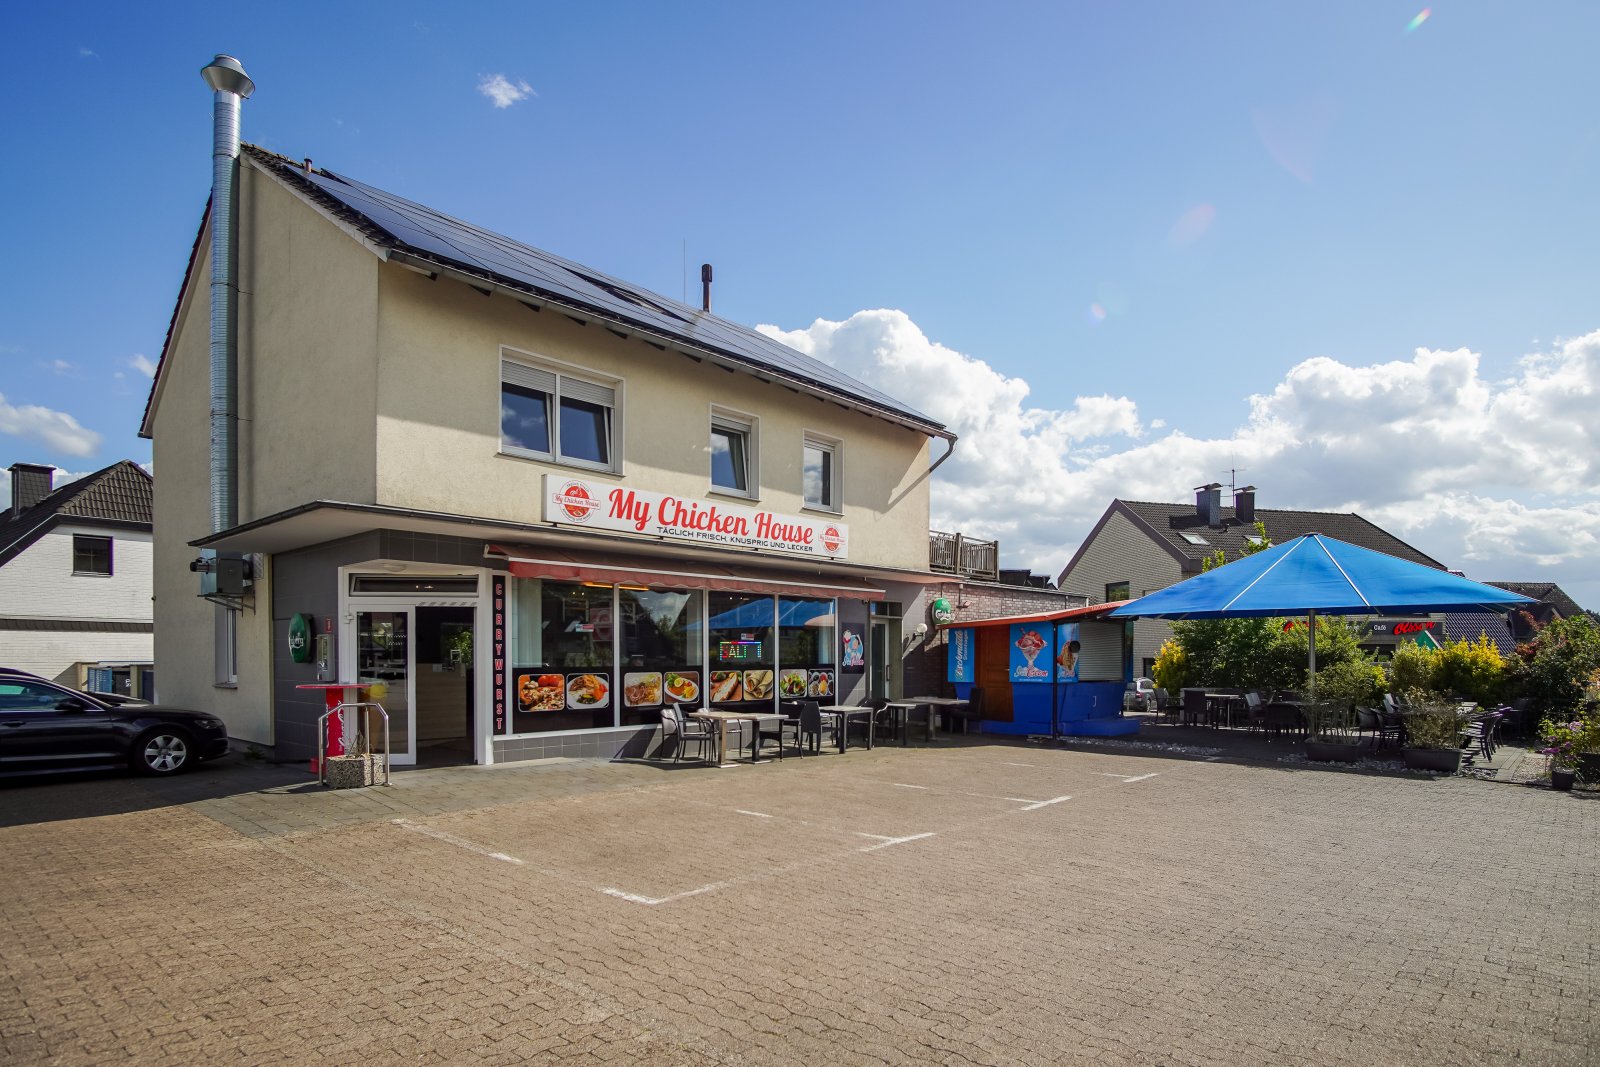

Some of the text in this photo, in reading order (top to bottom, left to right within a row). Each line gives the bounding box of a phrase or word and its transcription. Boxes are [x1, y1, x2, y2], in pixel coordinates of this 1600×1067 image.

[564, 497, 584, 505] Chicken
[608, 488, 813, 544] My Chicken House
[657, 526, 694, 538] TÄGLICH
[730, 536, 769, 547] KNUSPRIG
[770, 541, 785, 549] UND
[787, 543, 813, 552] LECKER
[494, 583, 504, 730] CURRYWURST
